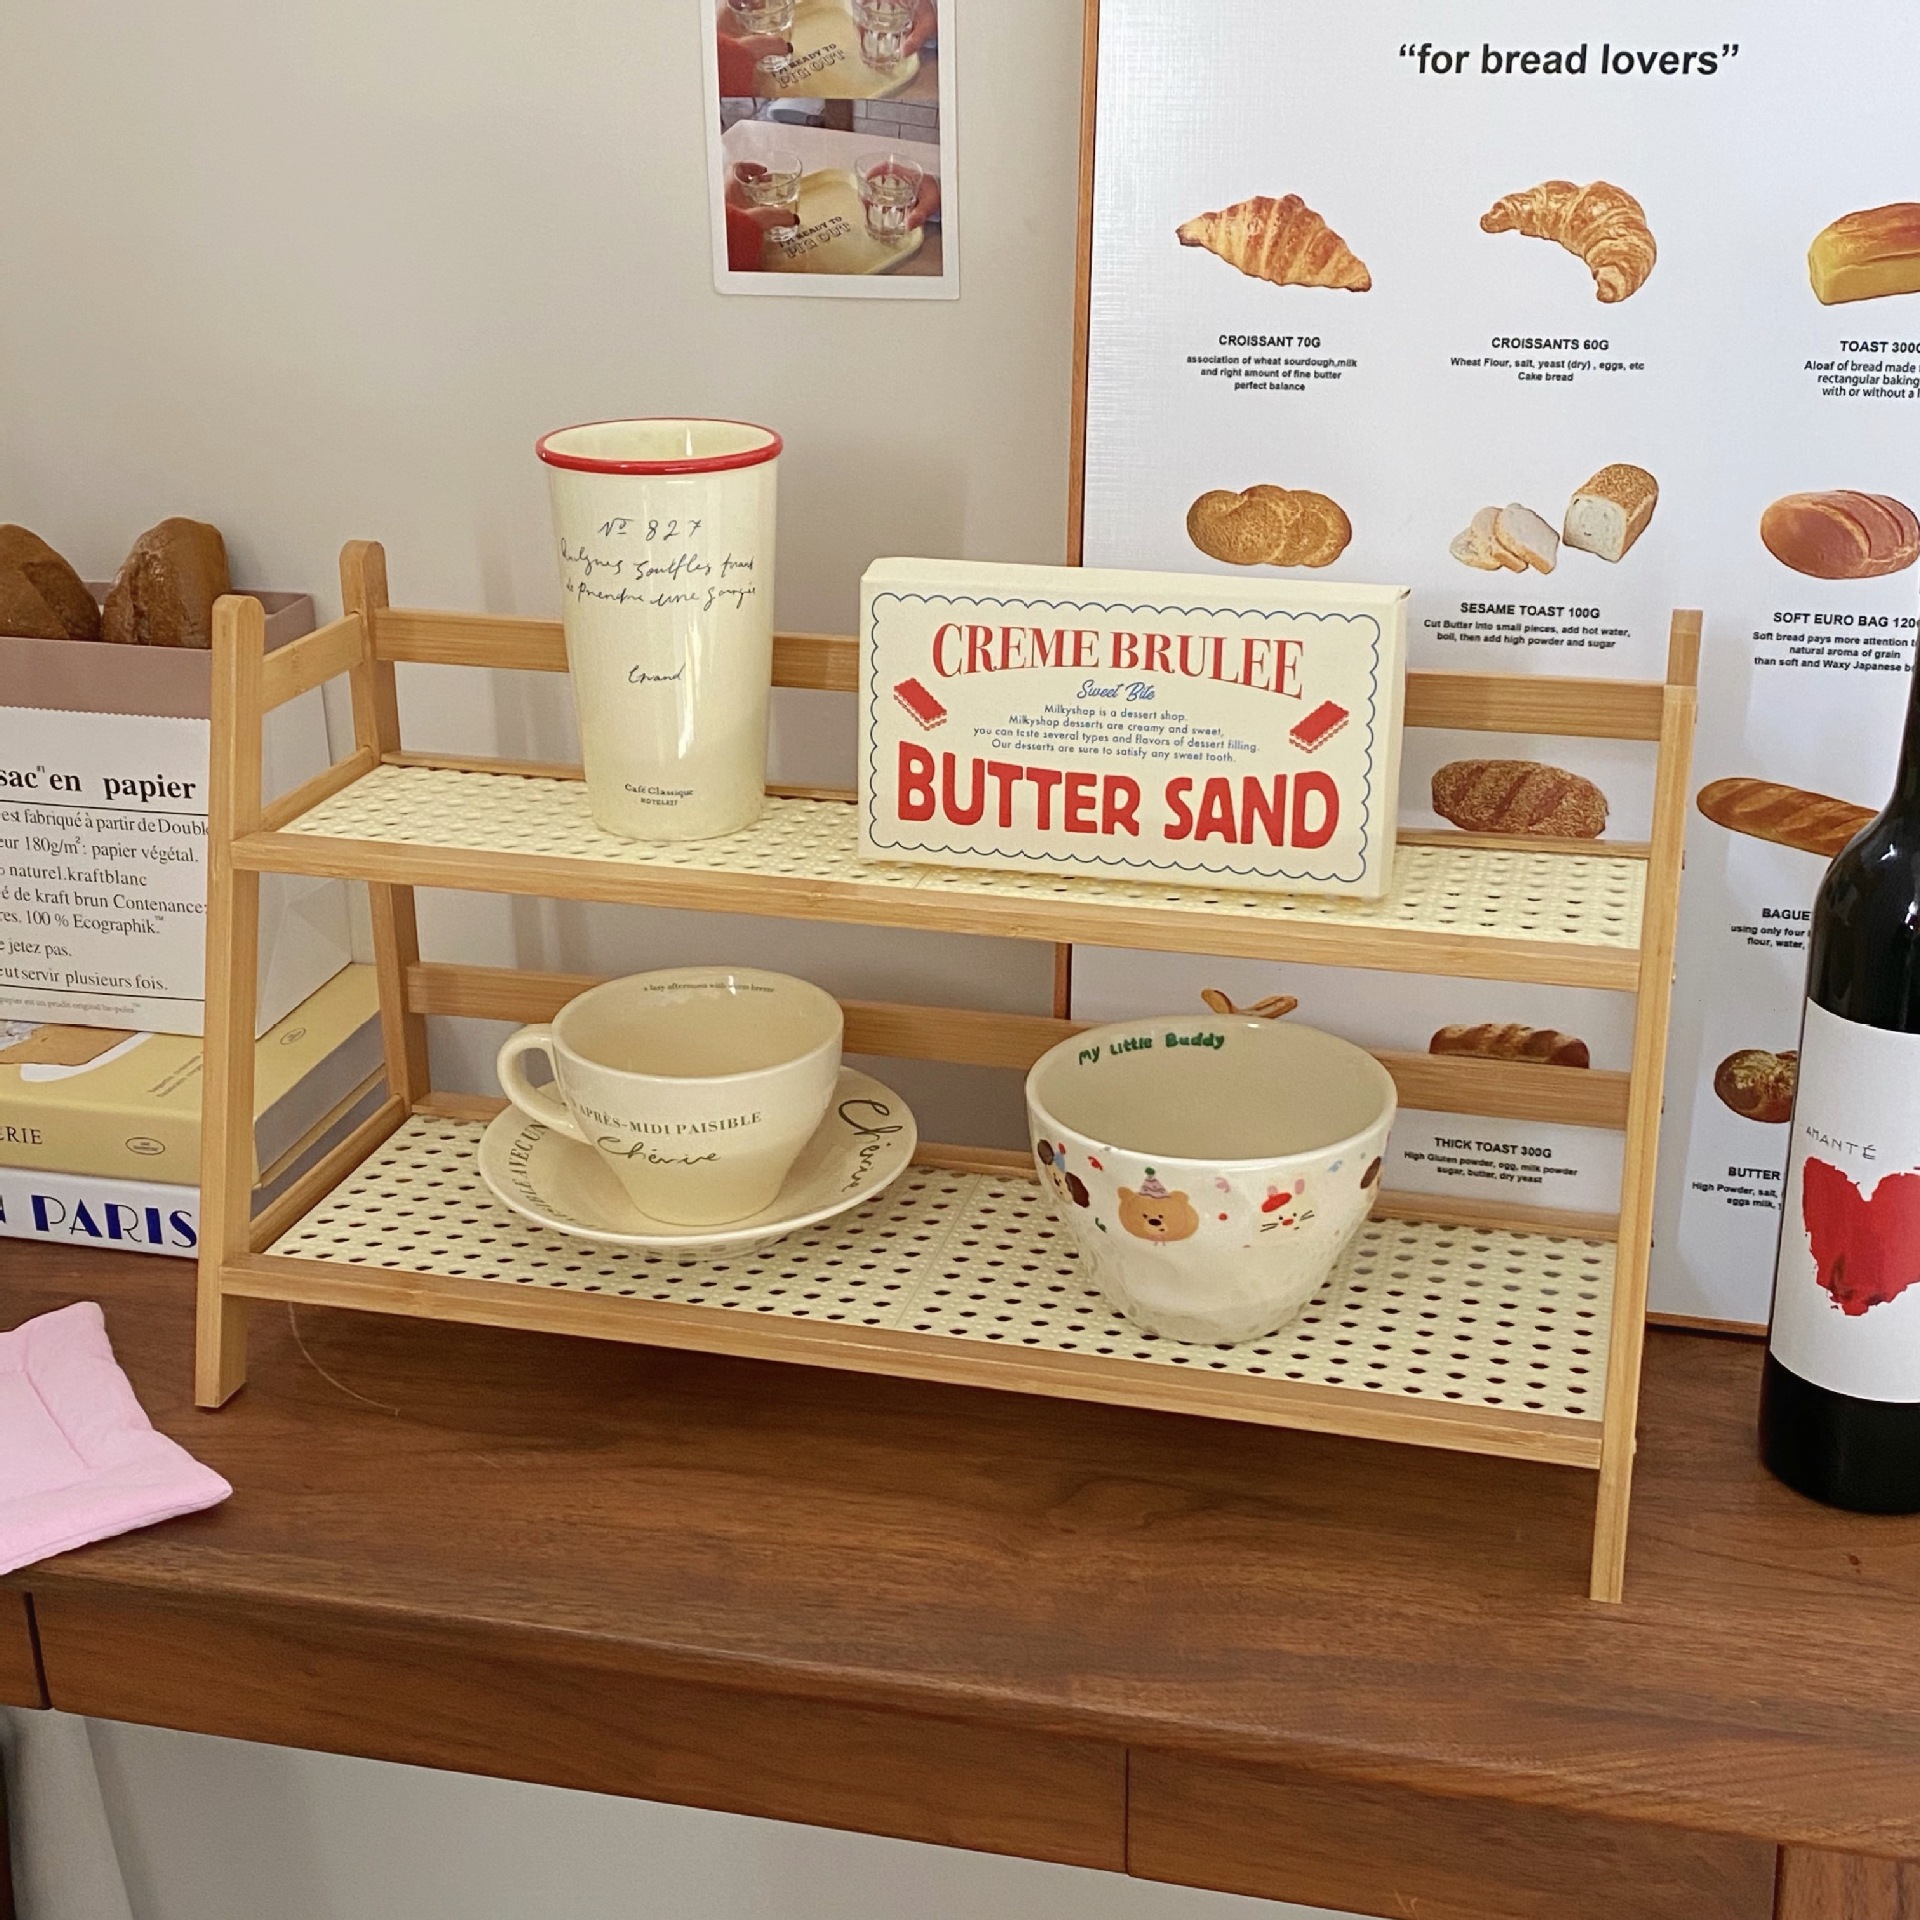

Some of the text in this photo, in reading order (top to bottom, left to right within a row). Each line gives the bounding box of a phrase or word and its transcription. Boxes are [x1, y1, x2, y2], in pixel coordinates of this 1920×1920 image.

[1399, 42, 1739, 75] “for bread lovers”
[1218, 334, 1321, 348] CROISSANT 70G
[1492, 337, 1609, 351] CROISSANTS 60G
[1840, 340, 1889, 353] TOAST
[1186, 355, 1240, 364] association
[1242, 356, 1252, 365] of
[1253, 356, 1282, 366] wheat
[1450, 357, 1645, 372] Wheat Flour, salt, yeast eggs, etc
[1836, 360, 1850, 371] of
[1850, 360, 1883, 372] bread
[1885, 362, 1916, 372] made
[1200, 367, 1342, 380] and right amount of fine butter
[1518, 372, 1574, 382] Cake bread
[1817, 374, 1880, 386] rectangular
[1234, 381, 1306, 391] perfect balance
[1822, 386, 1915, 398] with or without a
[1460, 602, 1600, 619] SESAME TOAST 100G
[1424, 619, 1598, 635] Cut Butter into small add hot
[1773, 612, 1811, 624] SOFT
[1814, 614, 1854, 626] EURO
[1858, 615, 1888, 628] BAG
[1437, 632, 1616, 650] boil, then add high powder and sugar
[1752, 631, 1908, 647] Soft bread pays more attention
[1789, 646, 1901, 660] natural aroma of grain
[932, 623, 1304, 700] CREME BRULEE
[1754, 657, 1902, 672] than soft and Waxy Japanese
[1076, 680, 1122, 700] Sweet
[1044, 705, 1095, 718] Milkyshop
[1099, 708, 1107, 716] is
[1120, 708, 1157, 720] dessert
[1008, 715, 1060, 728] Milkyshop
[1062, 718, 1103, 730] desserts
[1128, 724, 1164, 735] creamy
[1168, 725, 1188, 734] and
[974, 728, 992, 736] you
[1043, 731, 1079, 741] several
[1082, 733, 1109, 744] types
[1112, 734, 1133, 744] and
[1135, 734, 1170, 746] flavors
[1174, 736, 1185, 746] of
[1187, 737, 1224, 748] dessert
[992, 738, 1012, 748] Our
[1014, 740, 1054, 752] desserts
[1102, 746, 1113, 755] to
[1116, 747, 1148, 760] satisfy
[1151, 751, 1170, 760] any
[1174, 752, 1203, 760] sweet
[49, 774, 196, 802] en papier
[898, 741, 1340, 849] BUTTER SAND
[2, 808, 208, 835] est fabriqué à partir de Doubl
[91, 842, 198, 864] papier végétal.
[14, 886, 31, 902] de
[35, 888, 70, 905] kraft
[74, 891, 108, 908] brun
[26, 910, 51, 926] 100
[1731, 926, 1806, 937] using only four
[8, 938, 72, 959] jetez pas.
[1747, 936, 1772, 948] flour,
[21, 968, 168, 990] servir plusieurs fois.
[1165, 1032, 1224, 1050] Buddy
[676, 1112, 762, 1134] PAISIBLE
[1434, 1137, 1472, 1150] THICK
[1475, 1141, 1518, 1154] TOAST
[1728, 1166, 1781, 1181] BUTTER
[31, 1194, 198, 1248] PARIS
